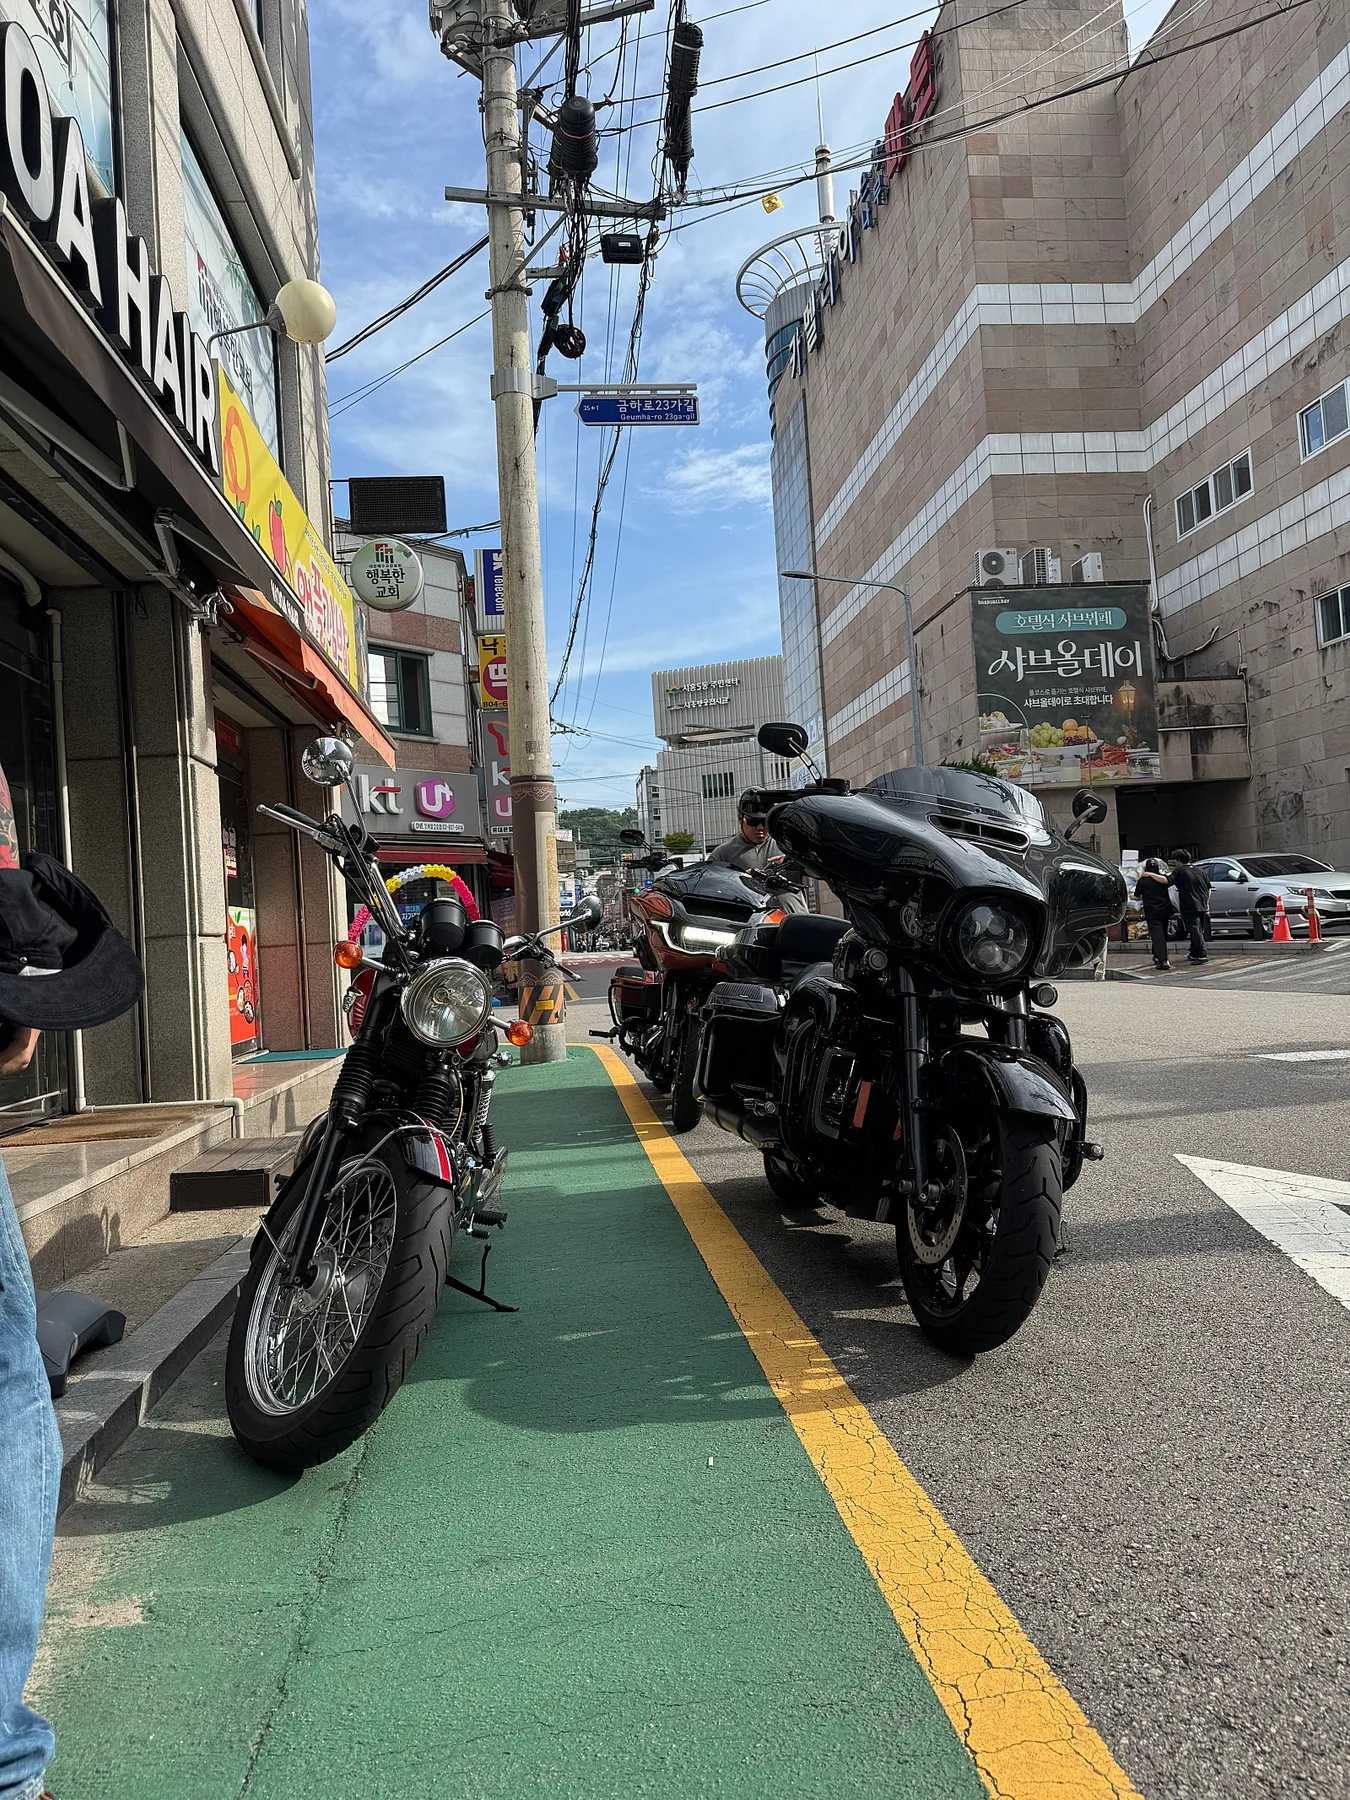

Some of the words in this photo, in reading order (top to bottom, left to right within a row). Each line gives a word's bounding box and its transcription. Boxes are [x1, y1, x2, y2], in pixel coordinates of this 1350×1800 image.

[95, 197, 220, 477] HAIR
[617, 399, 694, 412] 금하로23가길
[621, 413, 662, 421] Geumha-ro
[665, 412, 695, 421] 23ga-gil
[366, 568, 405, 584] 행복한
[375, 584, 400, 599] 교회
[1012, 613, 1055, 630] 호텔식
[1056, 610, 1112, 628] 샤브뷔페
[987, 638, 1143, 683] 샤브올데이
[710, 677, 739, 688] 주민센터
[1023, 695, 1073, 708] 샤브올데이로
[1073, 694, 1113, 706] 초대합니다
[358, 774, 404, 814] kt
